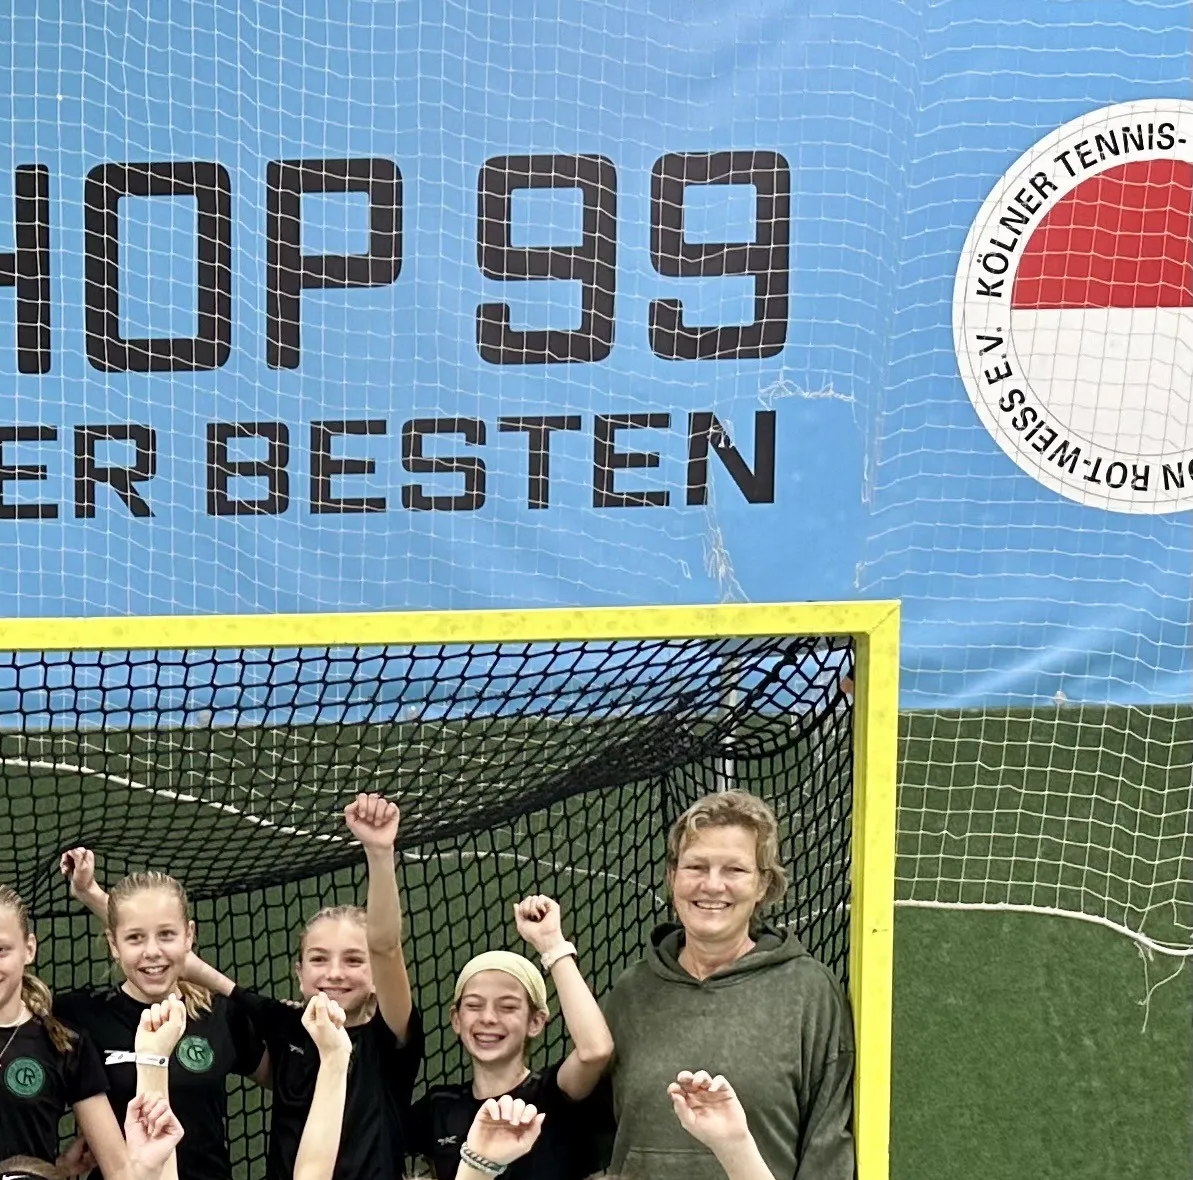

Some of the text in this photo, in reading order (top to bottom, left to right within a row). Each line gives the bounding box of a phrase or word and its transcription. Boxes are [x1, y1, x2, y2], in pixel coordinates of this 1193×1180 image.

[476, 150, 791, 365] 99
[976, 122, 1187, 298] KÖLNER TENNIS-
[976, 326, 1014, 385] E.V.
[206, 410, 776, 516] BESTEN
[998, 388, 1150, 492] ROT-WEISS
